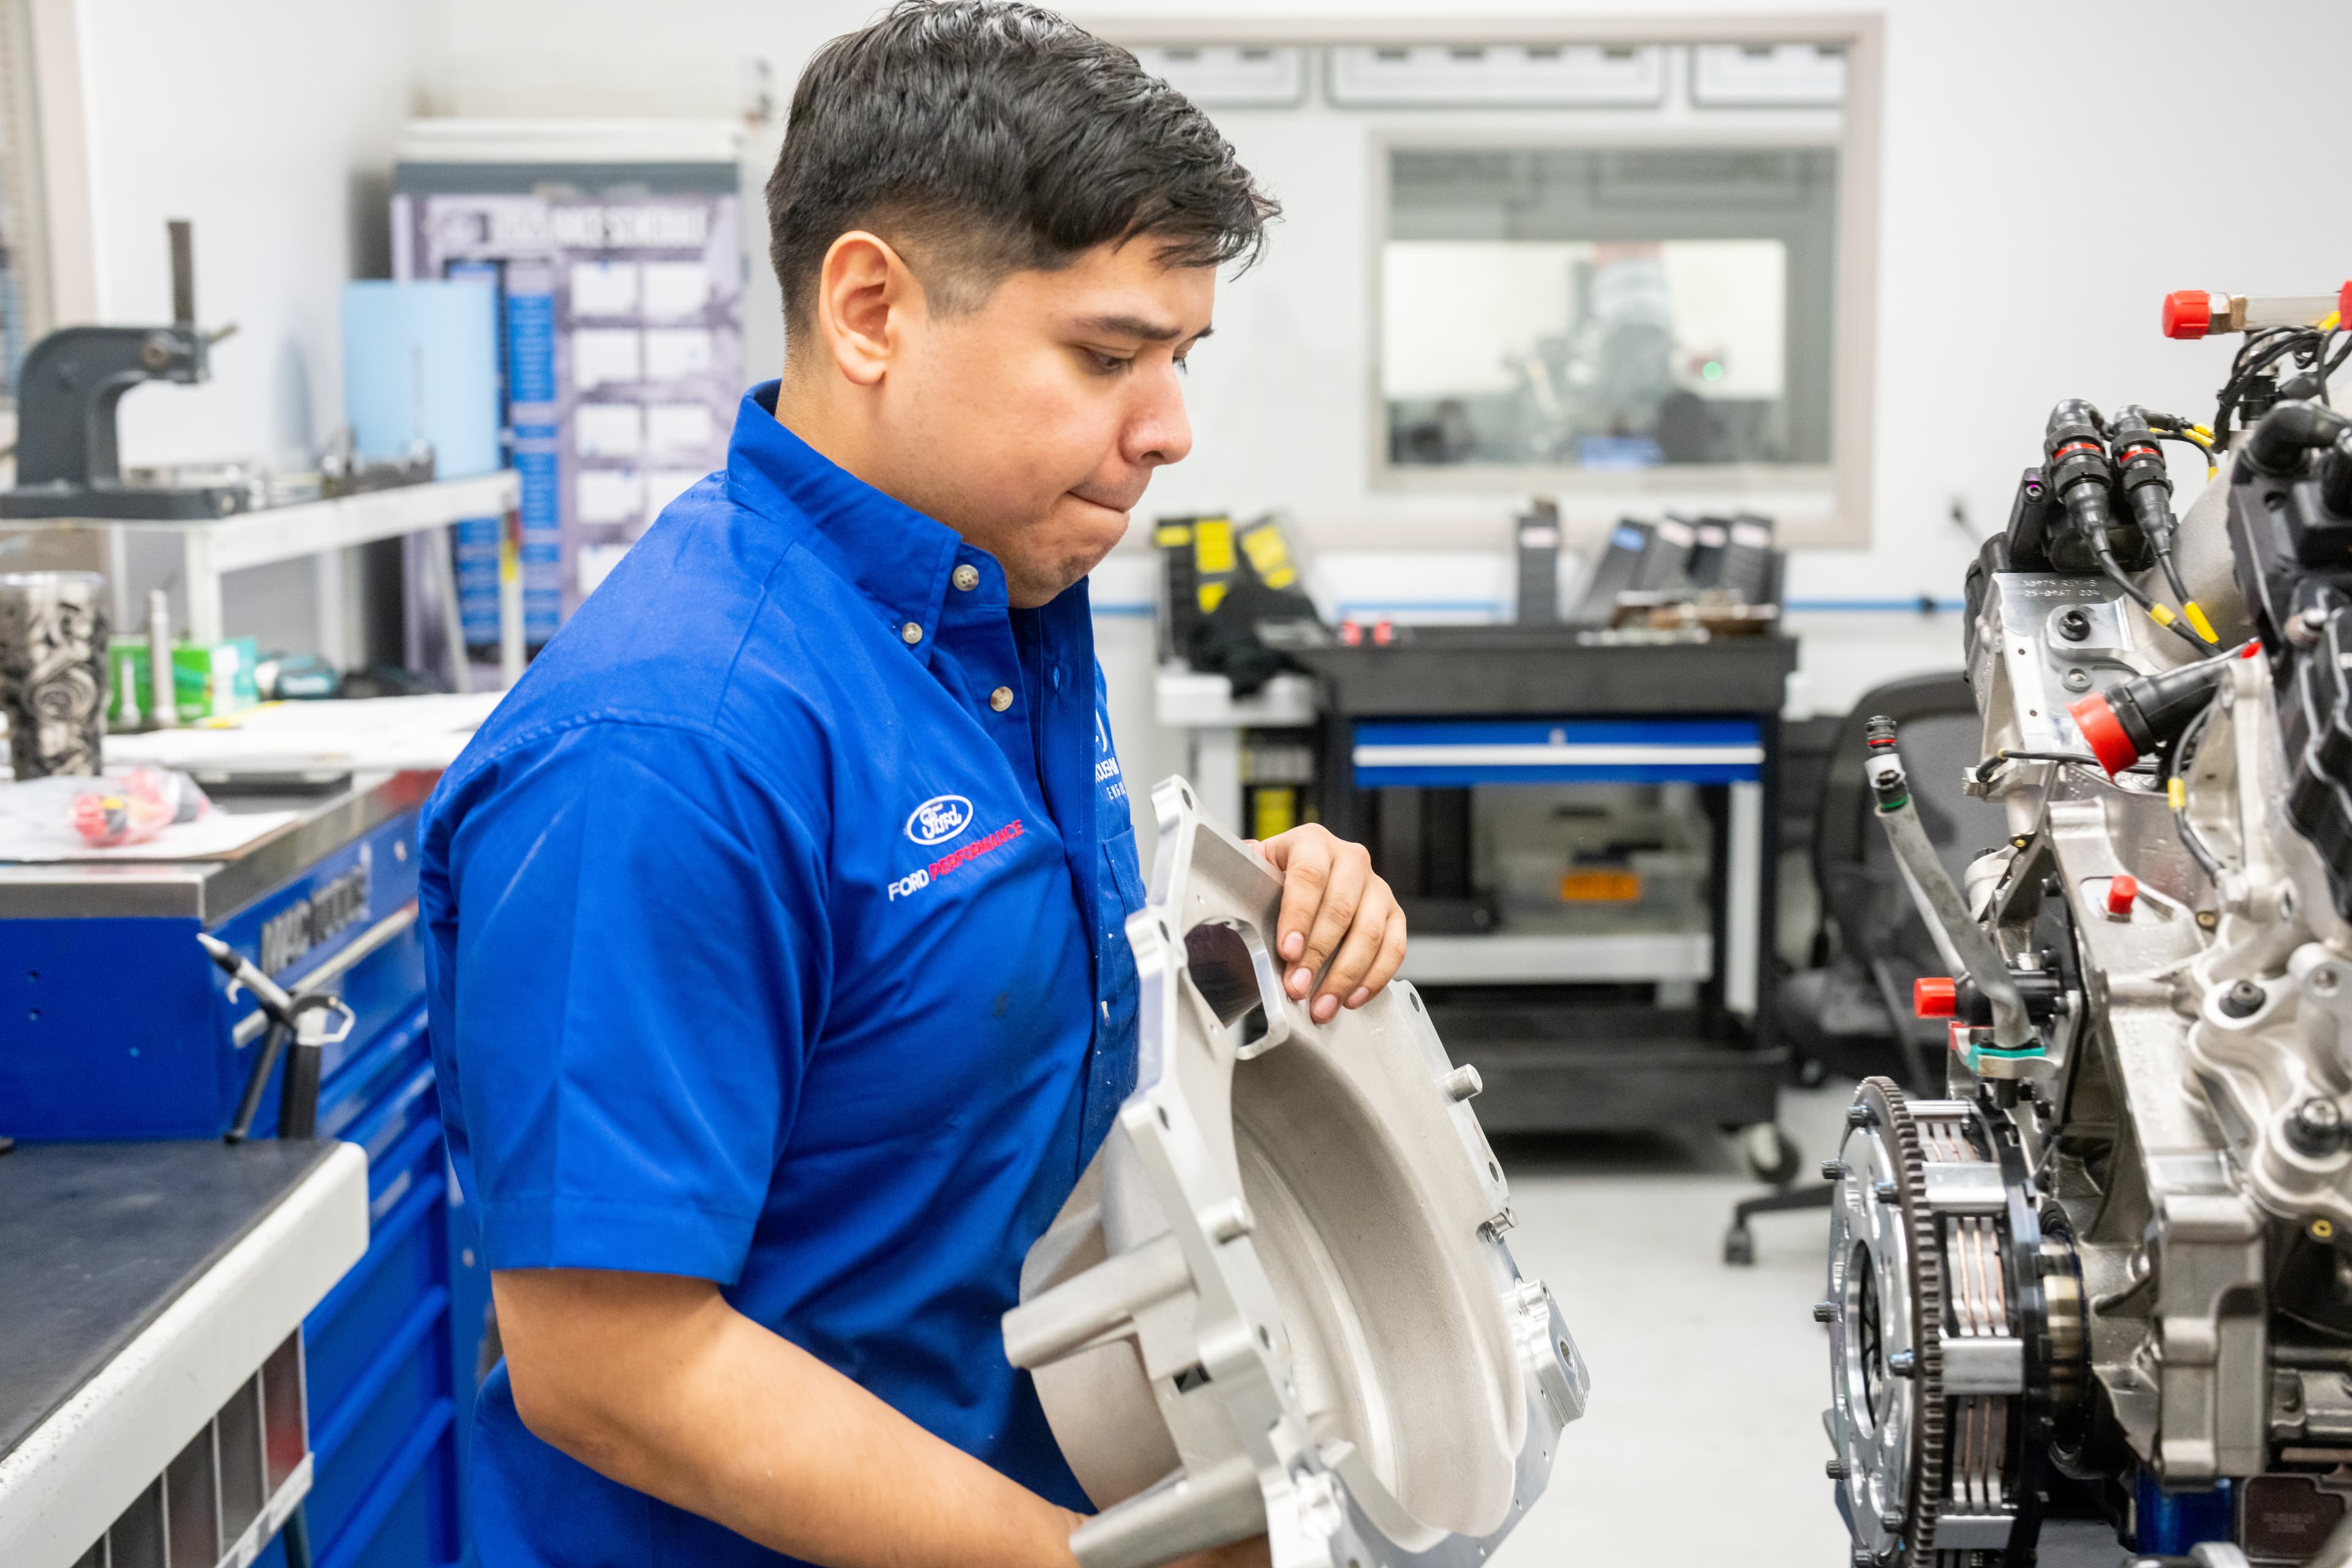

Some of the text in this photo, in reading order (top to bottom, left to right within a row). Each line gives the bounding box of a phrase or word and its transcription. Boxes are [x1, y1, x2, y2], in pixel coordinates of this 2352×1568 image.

[919, 803, 962, 840] Ford
[888, 819, 1025, 902] FORD PERFORMANCE
